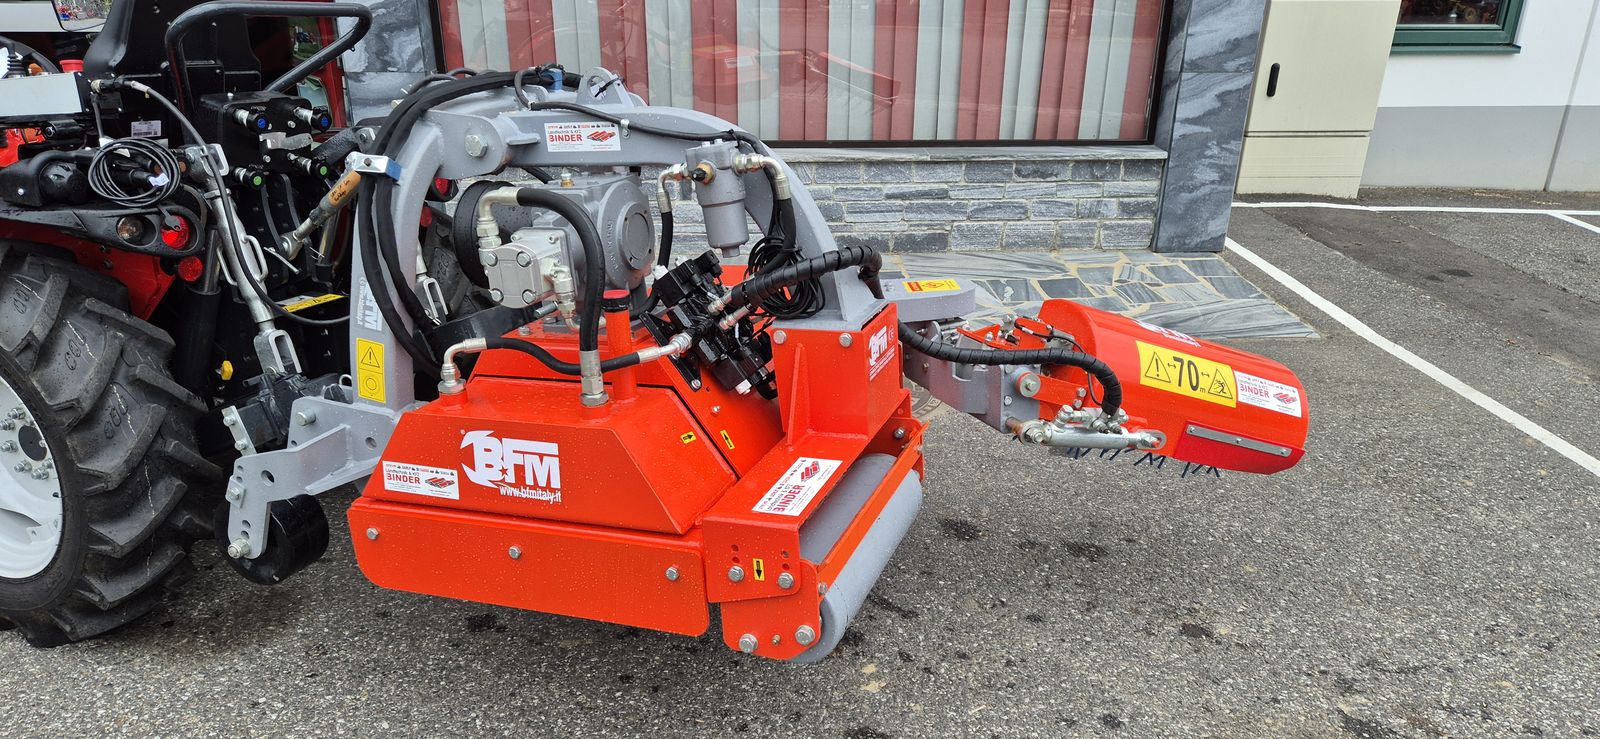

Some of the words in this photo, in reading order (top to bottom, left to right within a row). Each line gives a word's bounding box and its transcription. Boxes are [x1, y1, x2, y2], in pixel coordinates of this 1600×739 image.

[549, 134, 583, 142] BINDER
[1172, 356, 1200, 392] 70
[1240, 383, 1270, 398] BINDER
[460, 430, 561, 489] BFM
[386, 473, 421, 485] BINDER
[499, 486, 562, 504] www.bfmitaly.it
[773, 484, 805, 512] BINDER
